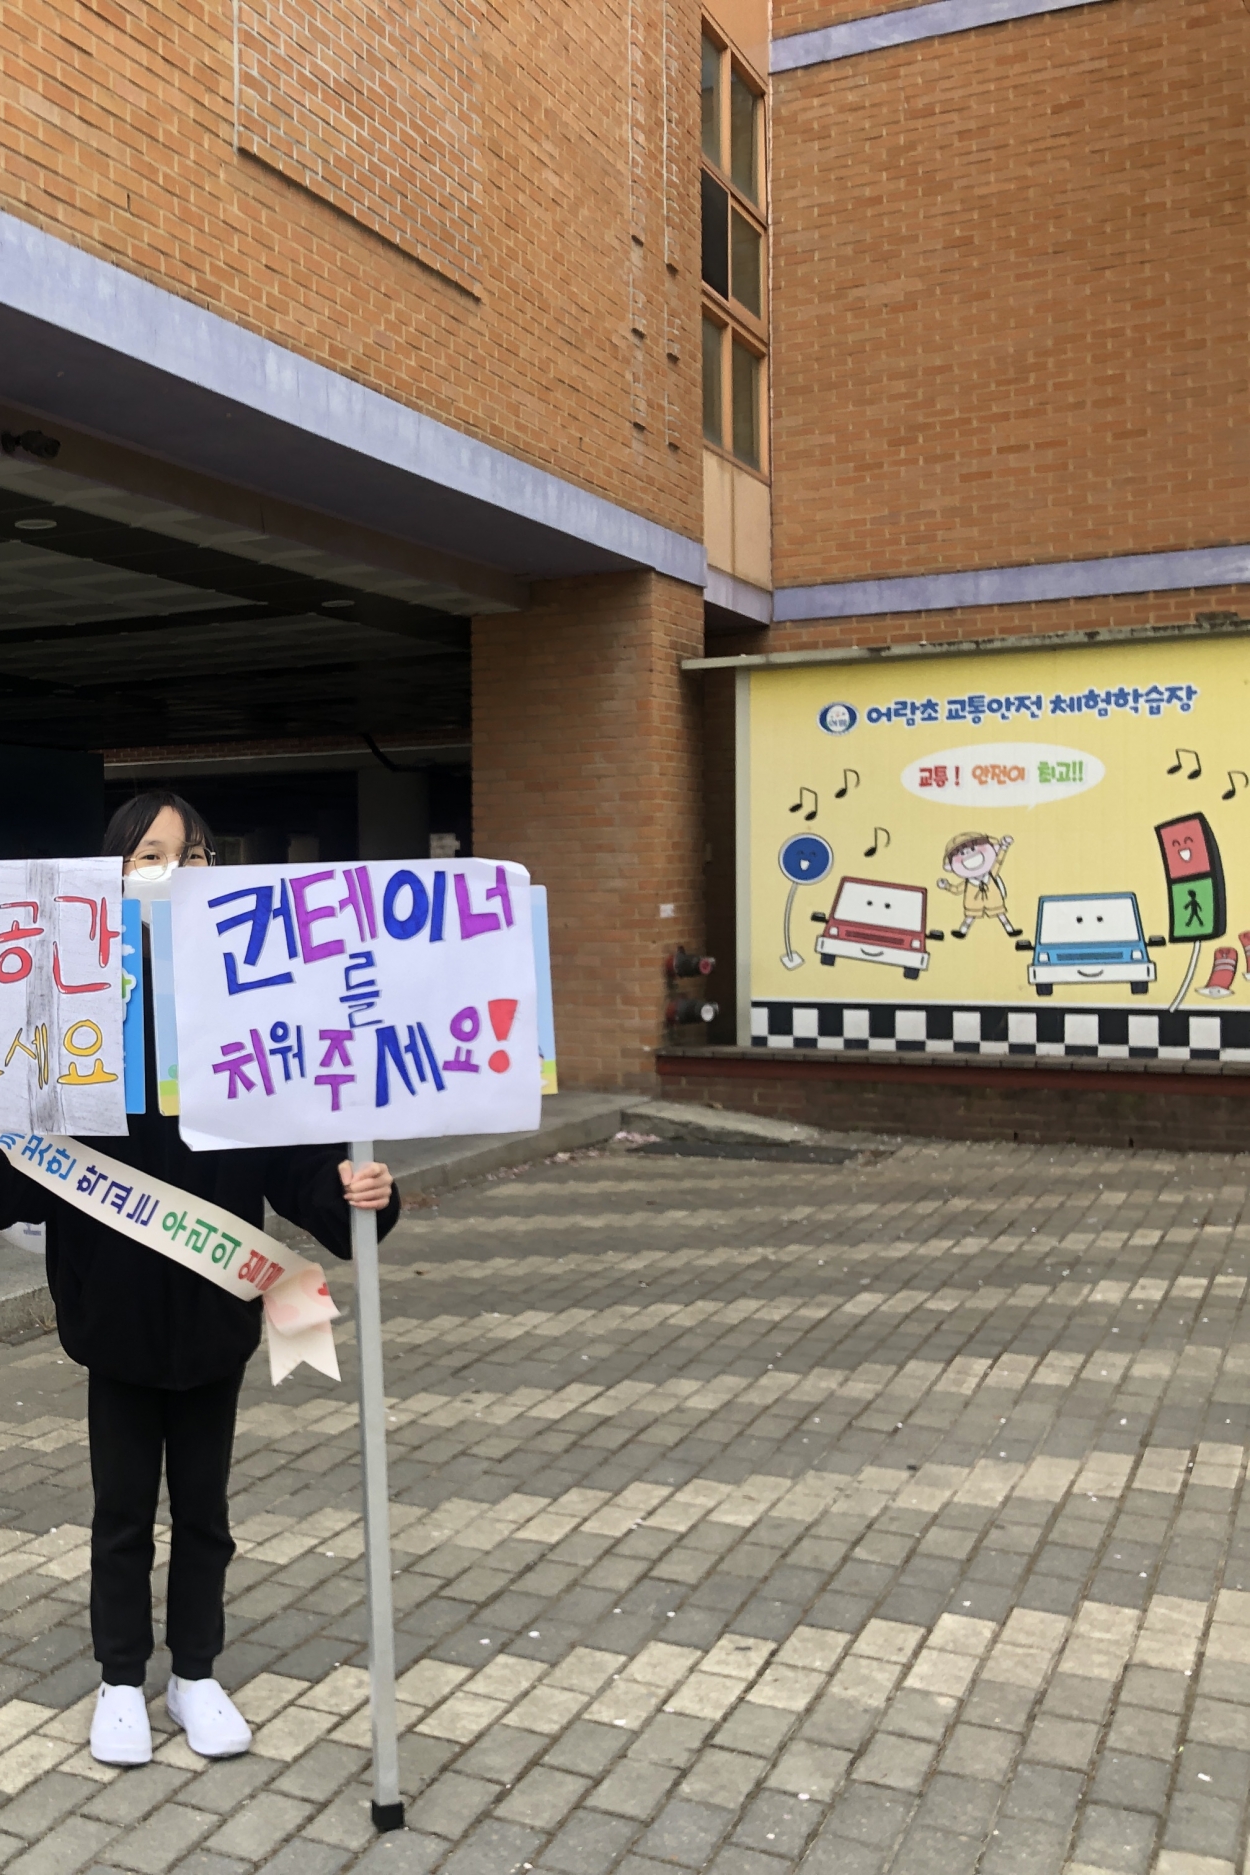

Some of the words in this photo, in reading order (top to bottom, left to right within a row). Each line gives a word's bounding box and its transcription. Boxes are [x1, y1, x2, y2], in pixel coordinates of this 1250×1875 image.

[866, 698, 939, 727] 어람초
[945, 694, 1043, 725] 교통안전
[1049, 685, 1198, 717] 체험학습장
[971, 763, 1026, 786] 안전이
[1037, 759, 1084, 784] 최고!!
[75, 1164, 161, 1228] 학교는
[161, 1209, 243, 1271] 우리의
